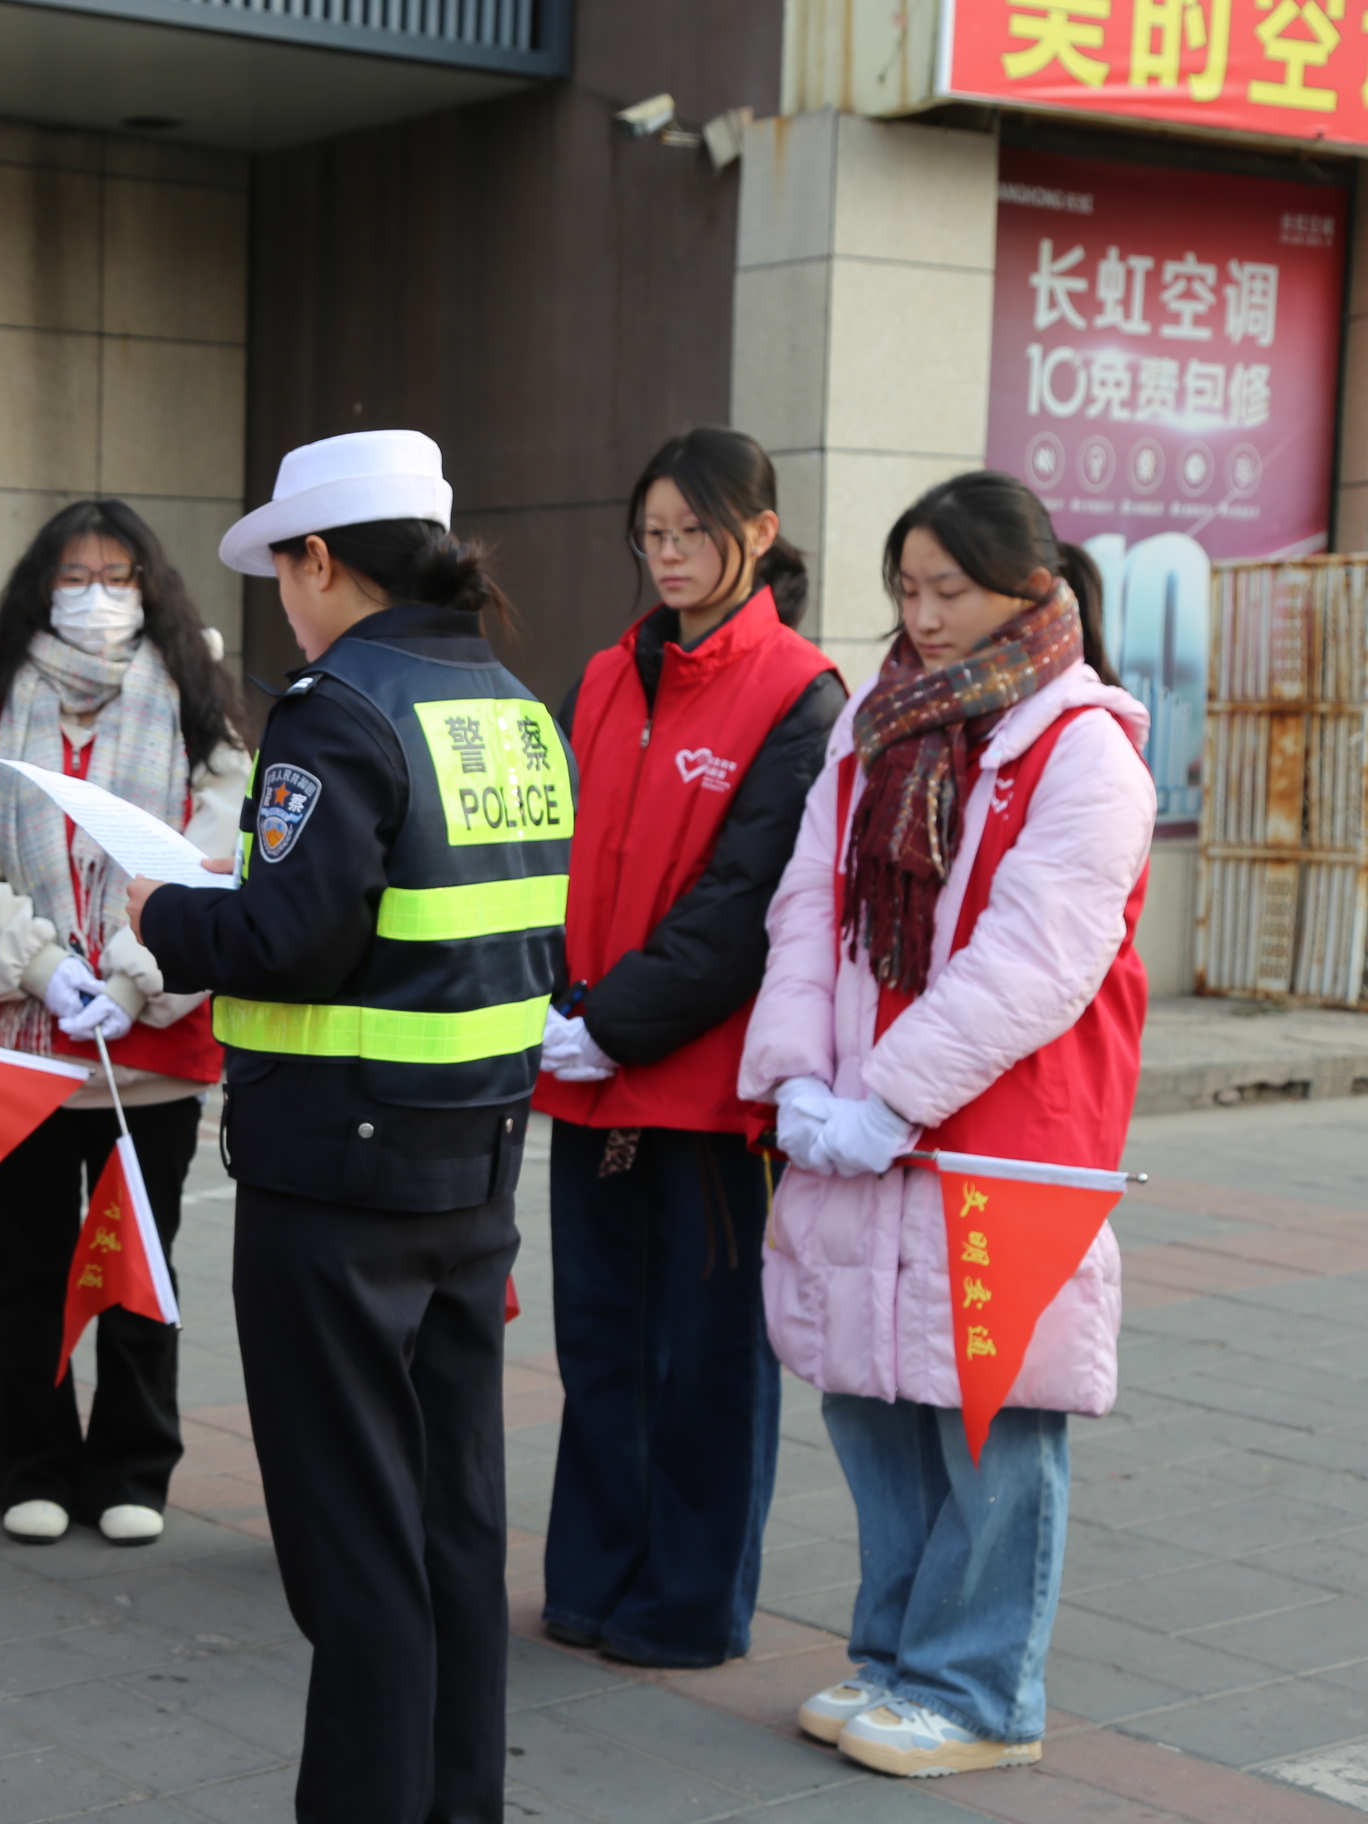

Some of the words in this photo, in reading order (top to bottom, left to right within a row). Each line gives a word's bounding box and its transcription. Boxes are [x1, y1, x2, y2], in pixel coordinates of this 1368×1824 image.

[1001, 0, 1368, 113] 美的空
[1028, 237, 1280, 348] 长虹空调
[444, 715, 551, 774] 警察
[459, 784, 561, 832] POLICE
[959, 1179, 998, 1361] 文明交通
